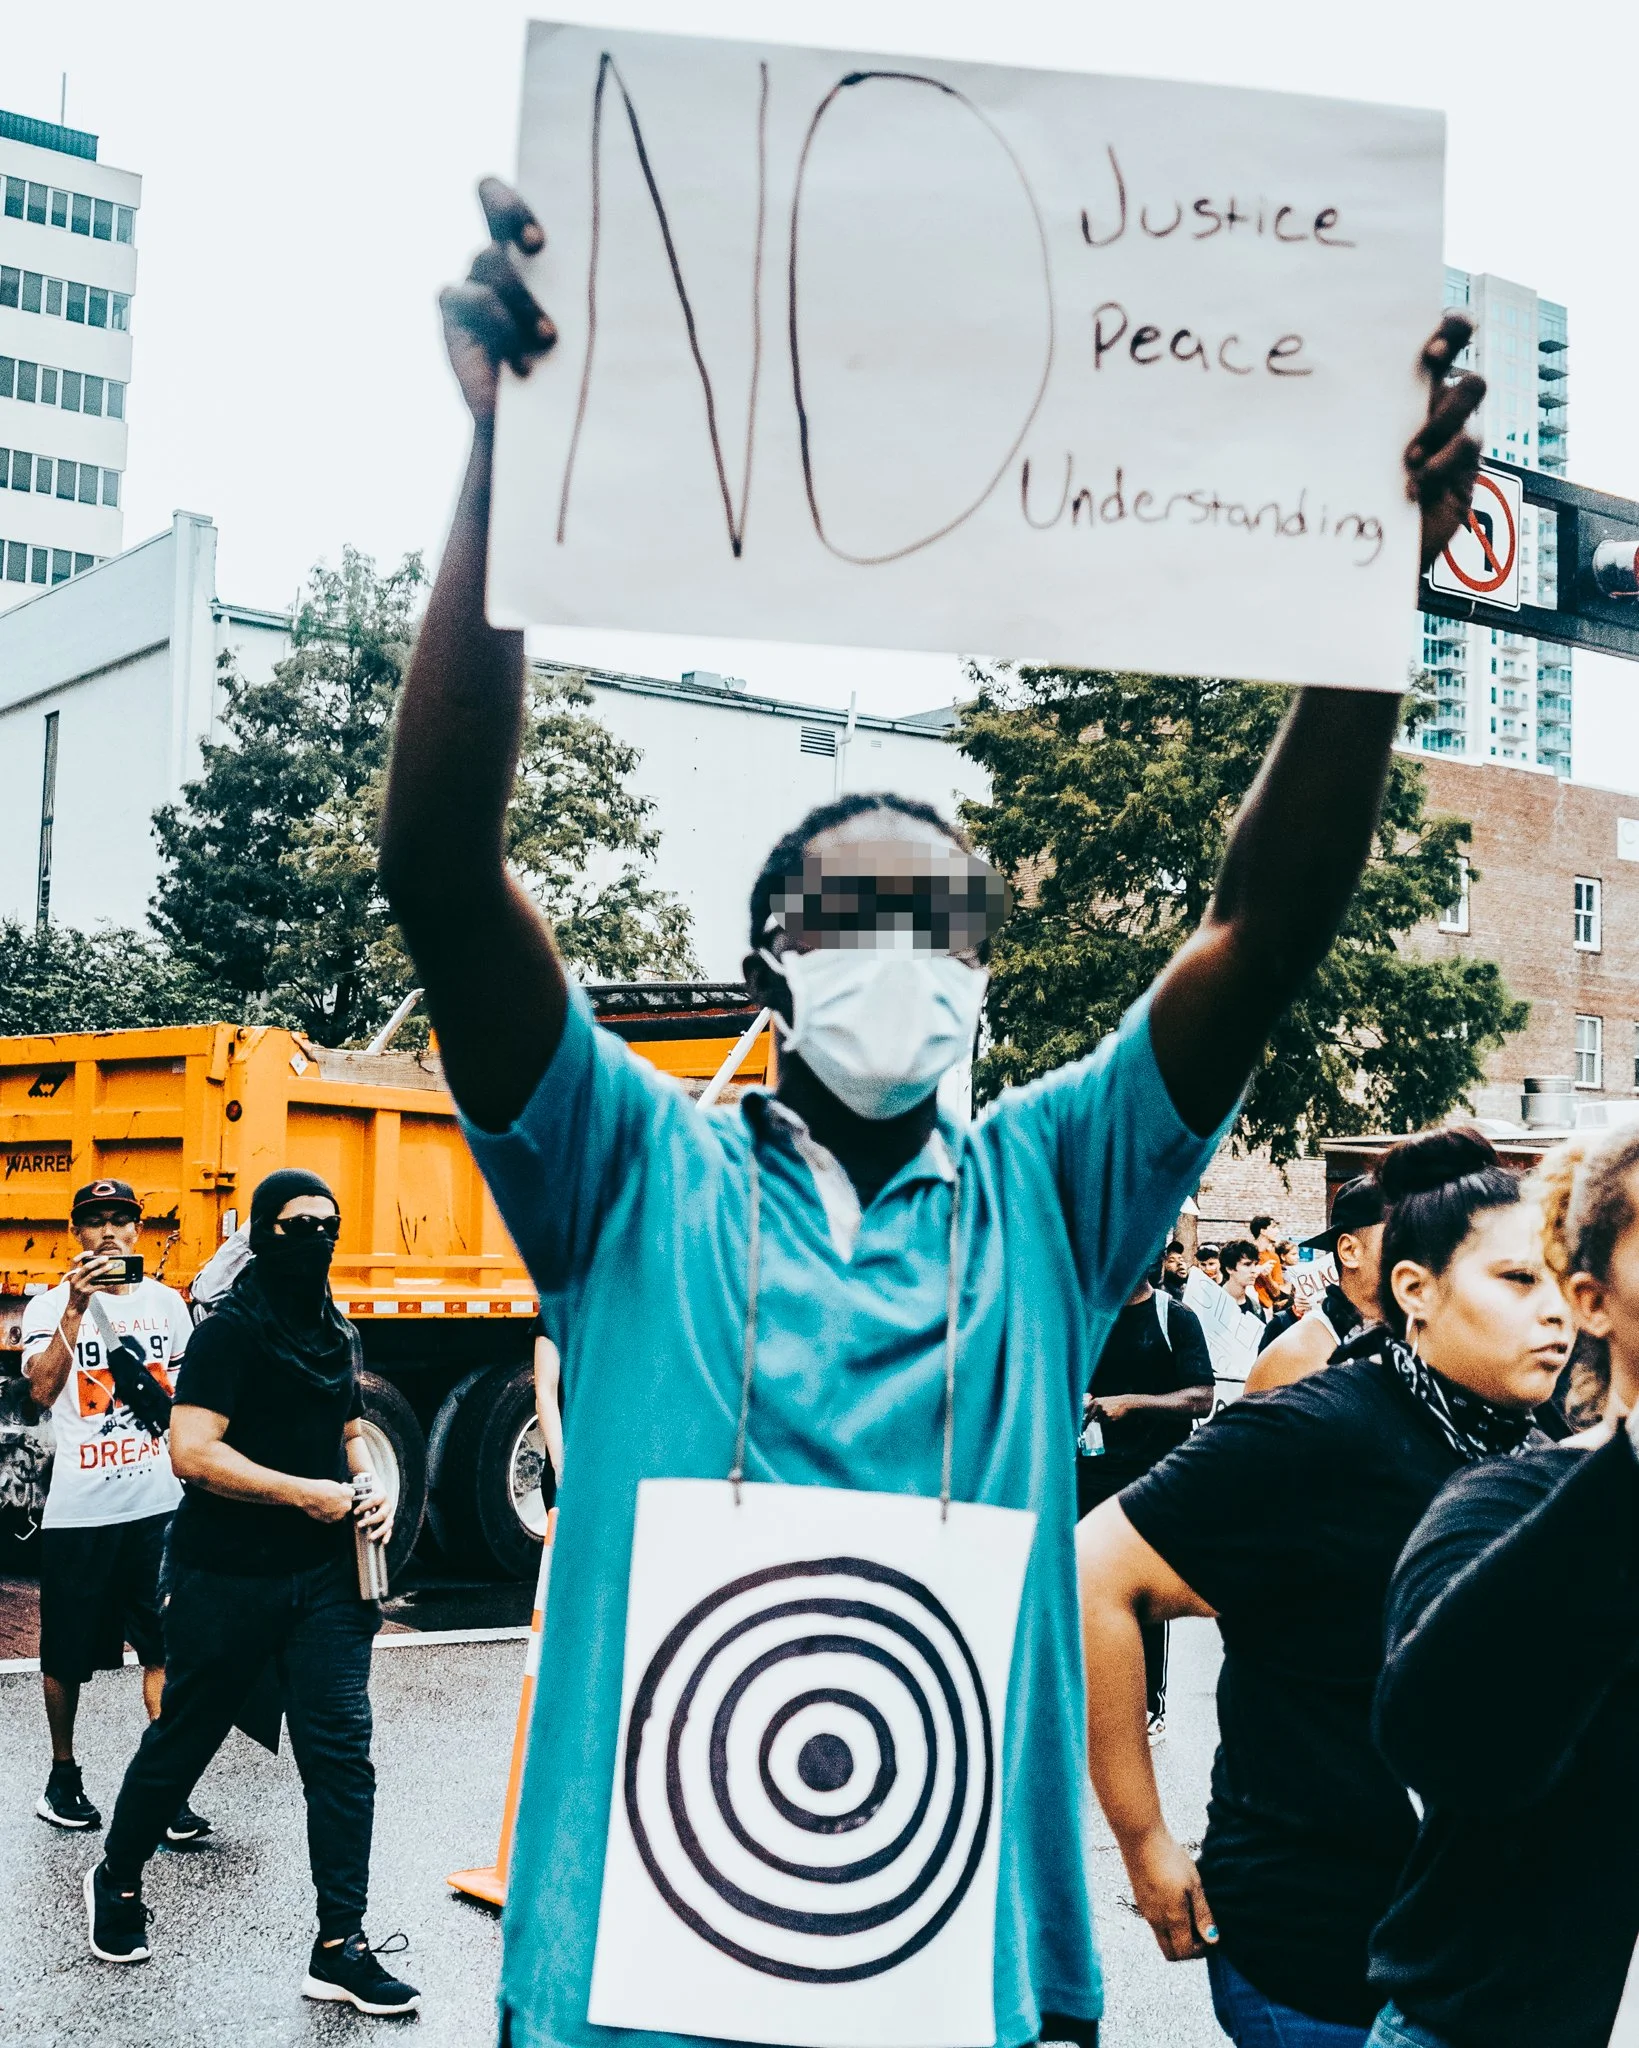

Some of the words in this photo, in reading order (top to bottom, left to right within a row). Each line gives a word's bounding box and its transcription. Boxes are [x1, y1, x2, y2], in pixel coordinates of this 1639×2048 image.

[1080, 144, 1357, 248] Justice
[556, 50, 1054, 566] NO
[1092, 301, 1313, 377] Peace
[1020, 451, 1384, 567] Understanding
[1297, 1265, 1340, 1298] BLAC
[76, 1341, 101, 1368] 19
[149, 1335, 169, 1359] 9
[132, 1318, 159, 1333] ALL
